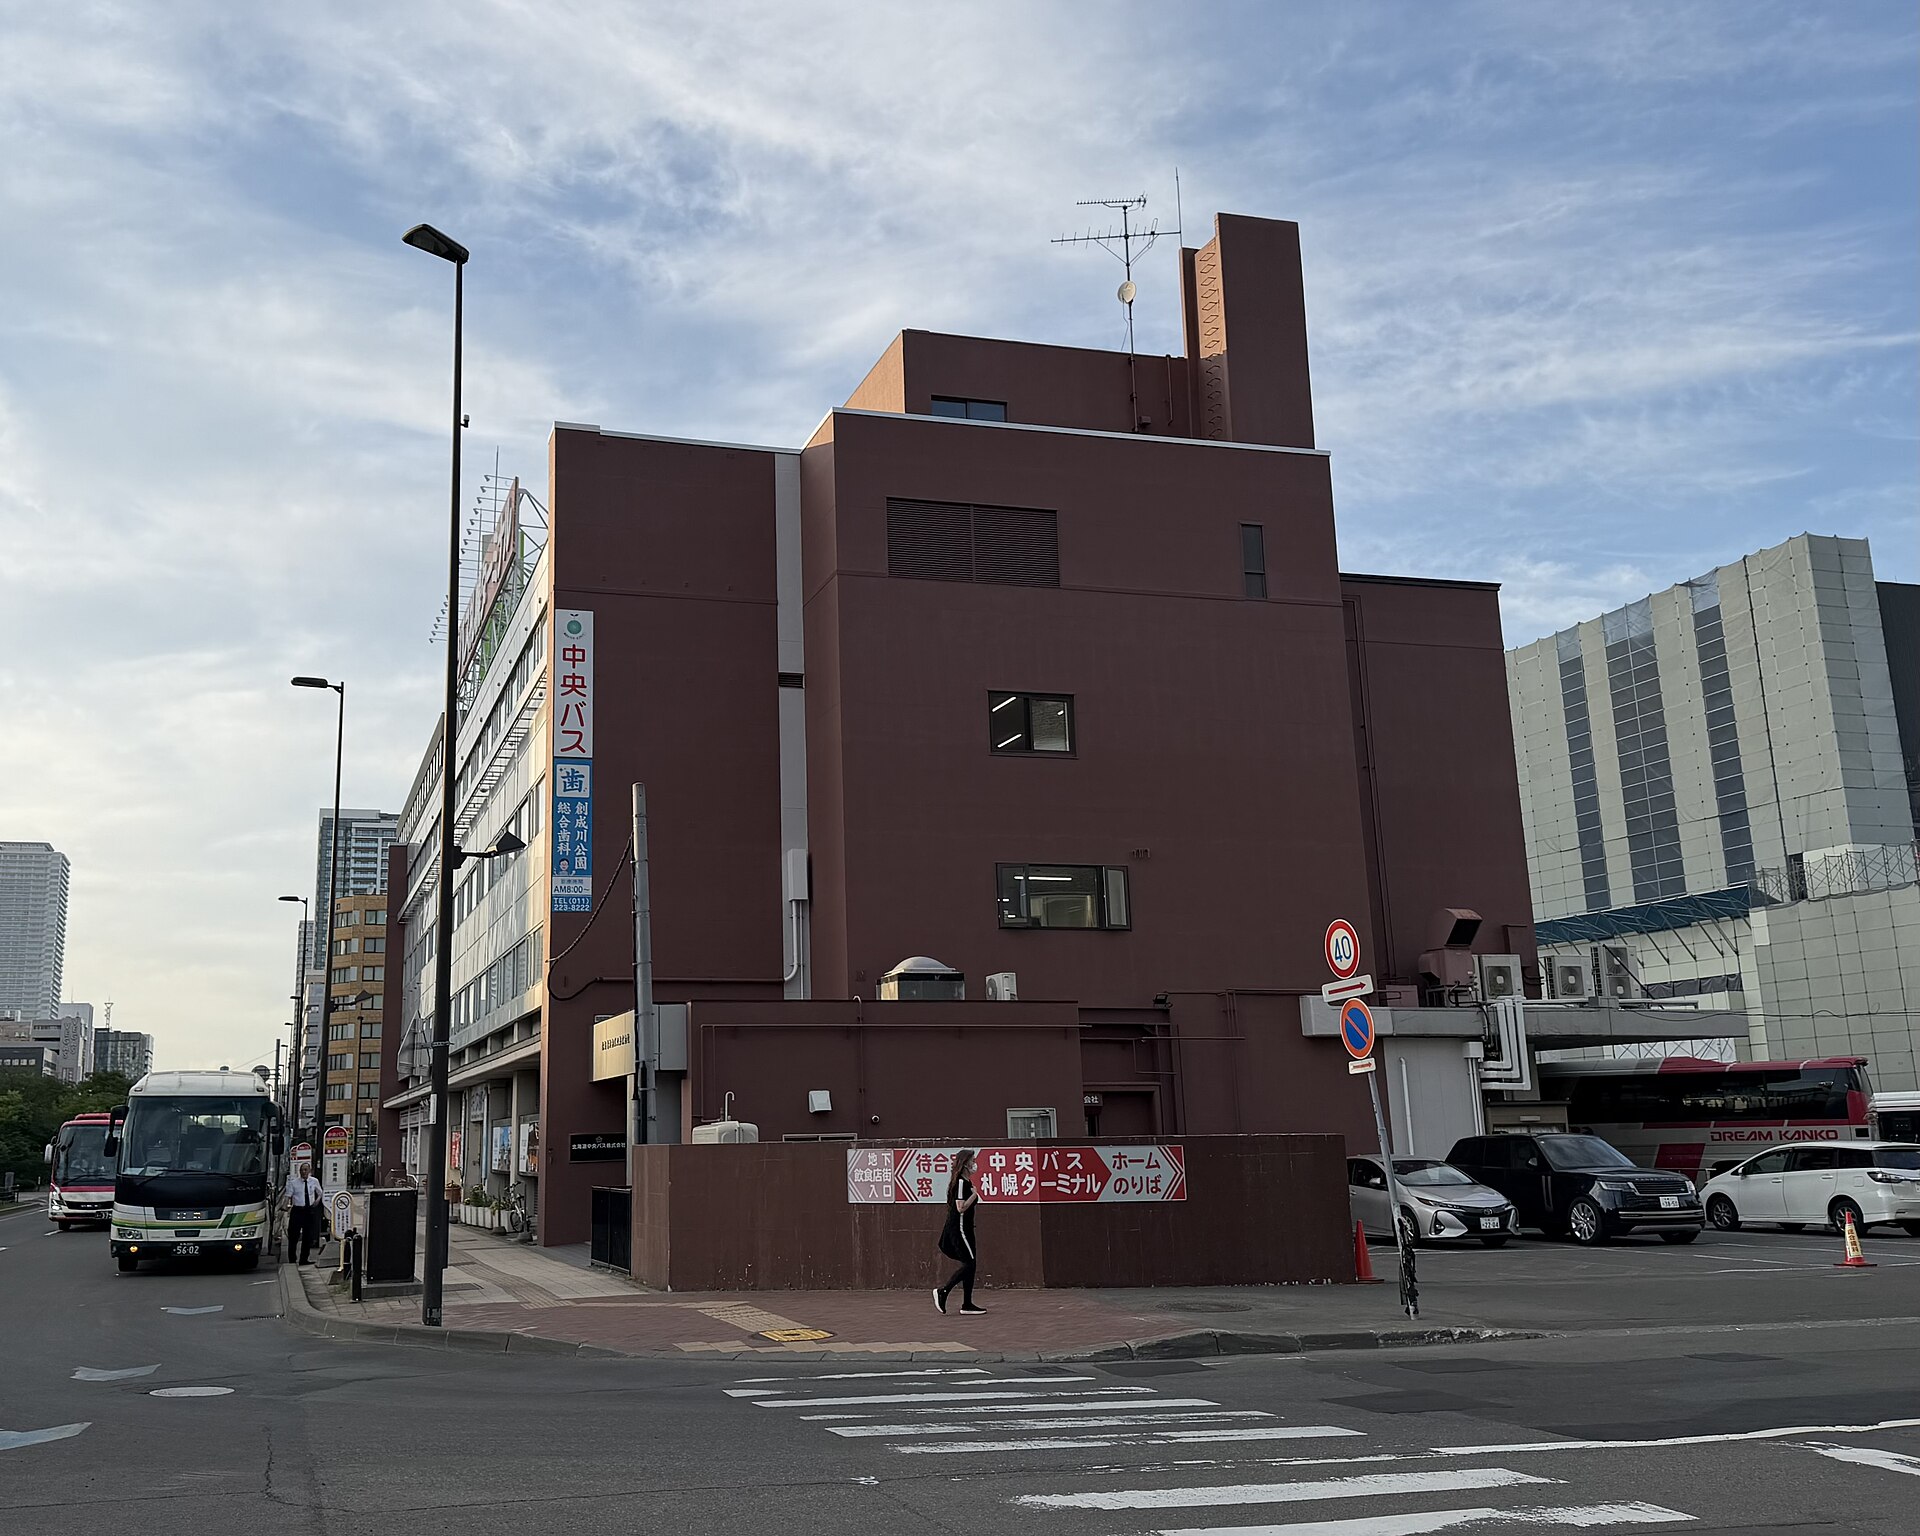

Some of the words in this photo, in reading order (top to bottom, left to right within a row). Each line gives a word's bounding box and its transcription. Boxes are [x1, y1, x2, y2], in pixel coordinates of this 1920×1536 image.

[560, 644, 587, 754] 中央バス
[561, 768, 585, 793] 歯
[557, 801, 571, 856] 総合歯科
[574, 801, 588, 871] 創成川公園
[1334, 935, 1352, 962] 40
[1710, 1130, 1773, 1142] DREAM
[1779, 1129, 1838, 1141] KANKO
[867, 1152, 892, 1166] 地下
[989, 1150, 1083, 1172] 中央バス
[1112, 1151, 1161, 1170] ホーム
[854, 1168, 892, 1182] 飲食店街
[980, 1172, 1102, 1196] 札幌ターミナル
[1113, 1173, 1162, 1195] のりば
[868, 1184, 892, 1198] 入口
